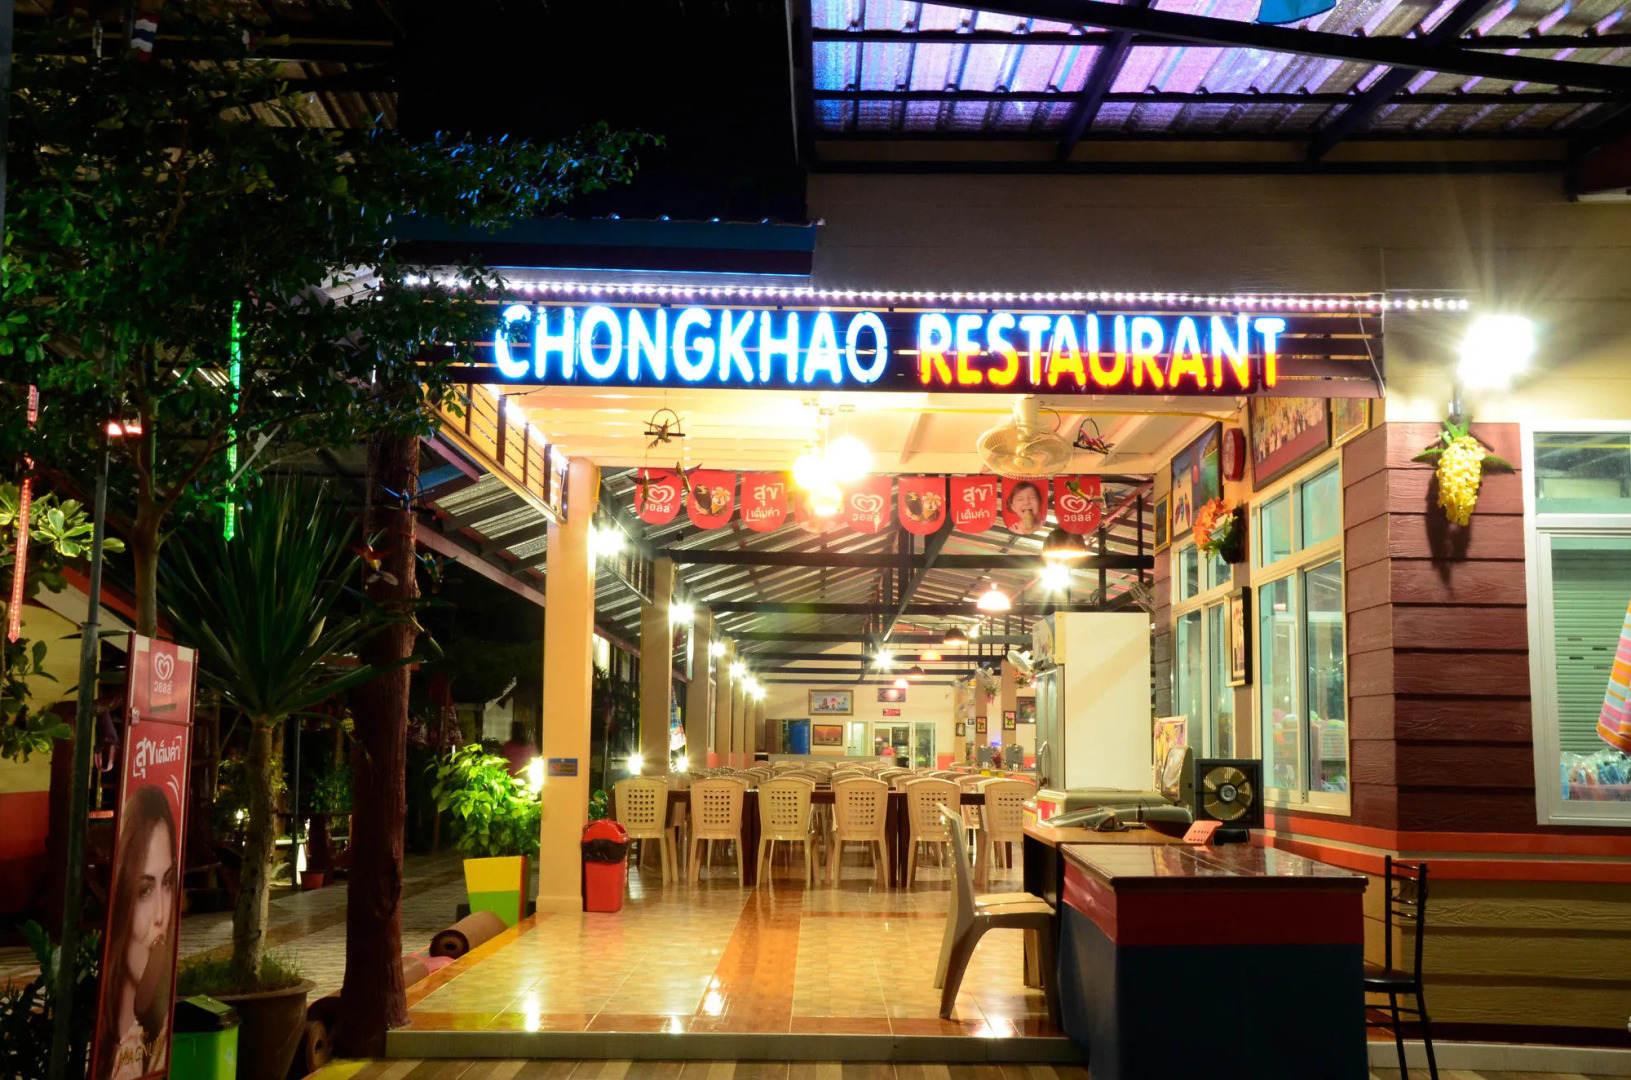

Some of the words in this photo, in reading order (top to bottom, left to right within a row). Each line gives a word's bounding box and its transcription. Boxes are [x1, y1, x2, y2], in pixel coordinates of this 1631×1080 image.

[494, 304, 889, 384] CHONGKHAO
[918, 312, 1287, 390] RESTAURANT
[754, 485, 779, 506] สุข
[963, 486, 988, 508] สุข
[1063, 511, 1094, 522] วอลล์
